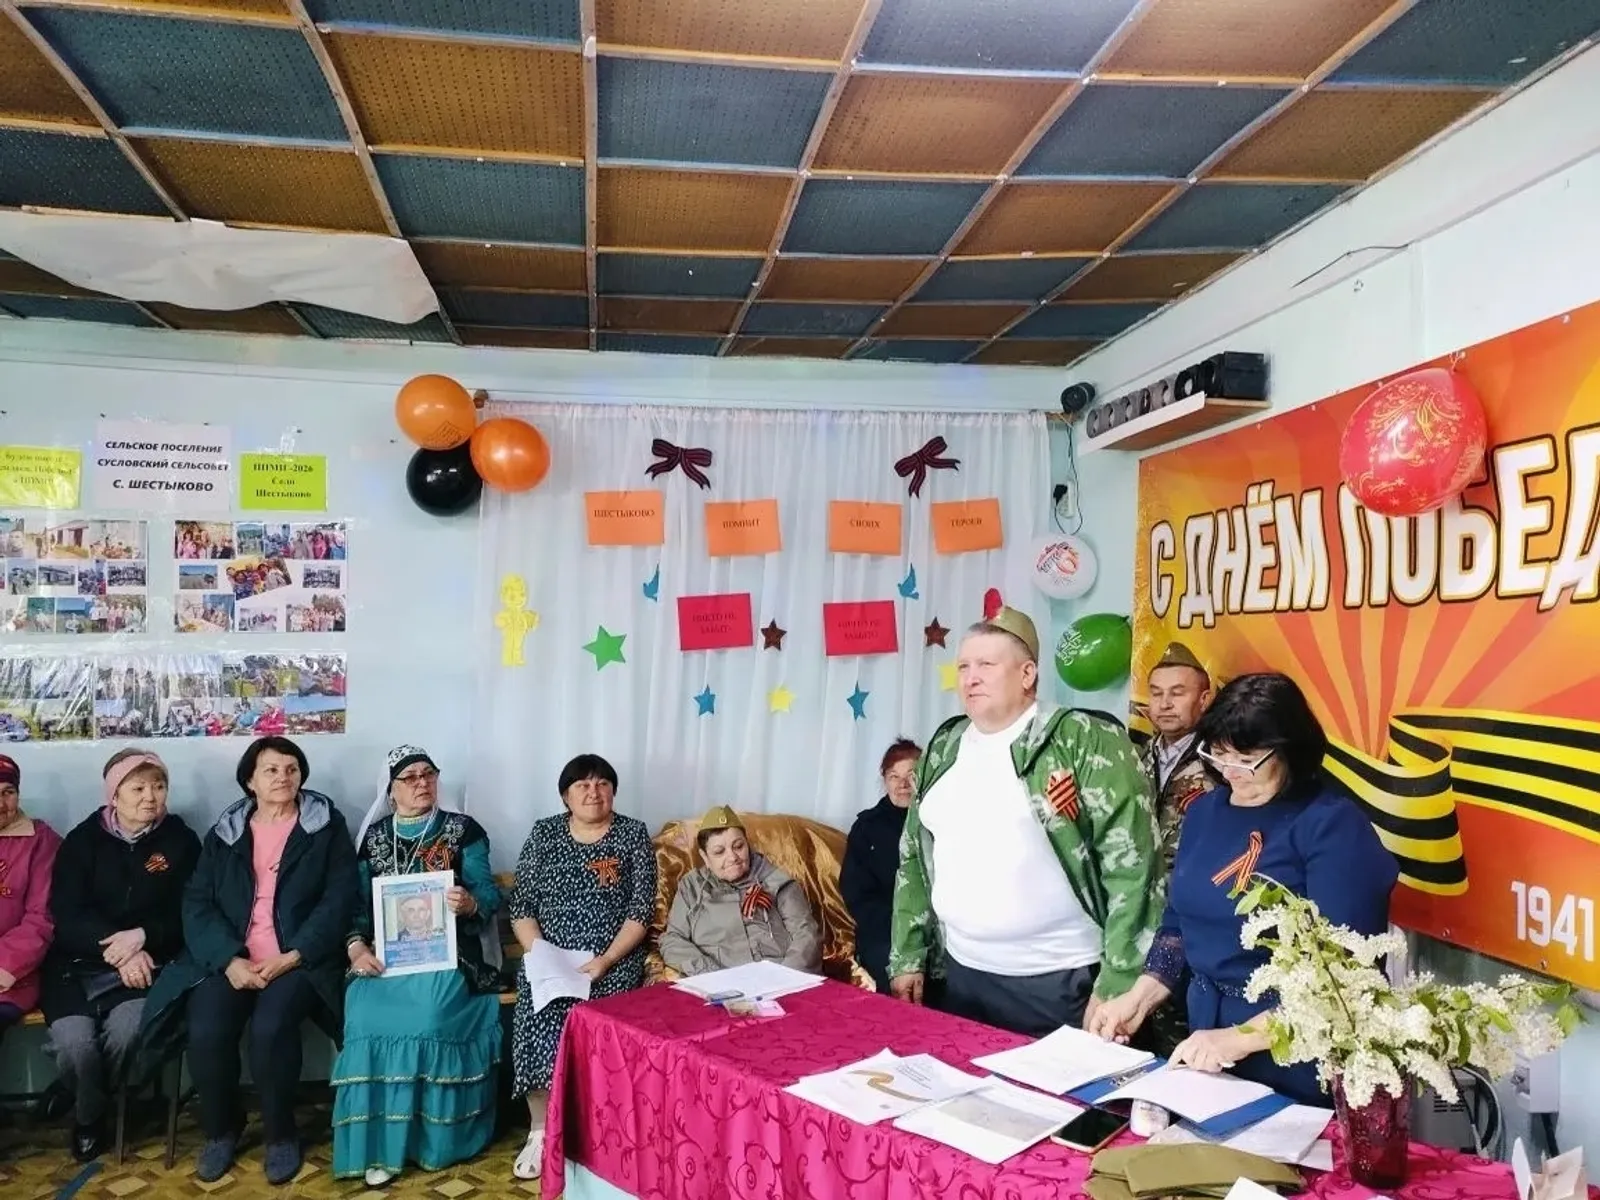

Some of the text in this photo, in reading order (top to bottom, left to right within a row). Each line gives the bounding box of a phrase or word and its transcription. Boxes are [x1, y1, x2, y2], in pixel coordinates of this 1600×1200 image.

[105, 441, 223, 454] СЕЛЬСКОЕ ПОСЕЛЕНИЕ
[97, 458, 169, 469] СУСЛОВСКИЙ
[112, 479, 214, 492] С. ШЕСТЫКОВО
[593, 509, 656, 519] ШЕСТЫКОВО
[1149, 520, 1177, 618] С
[1178, 479, 1331, 628] ДНЁМ
[1511, 880, 1595, 962] 1941
